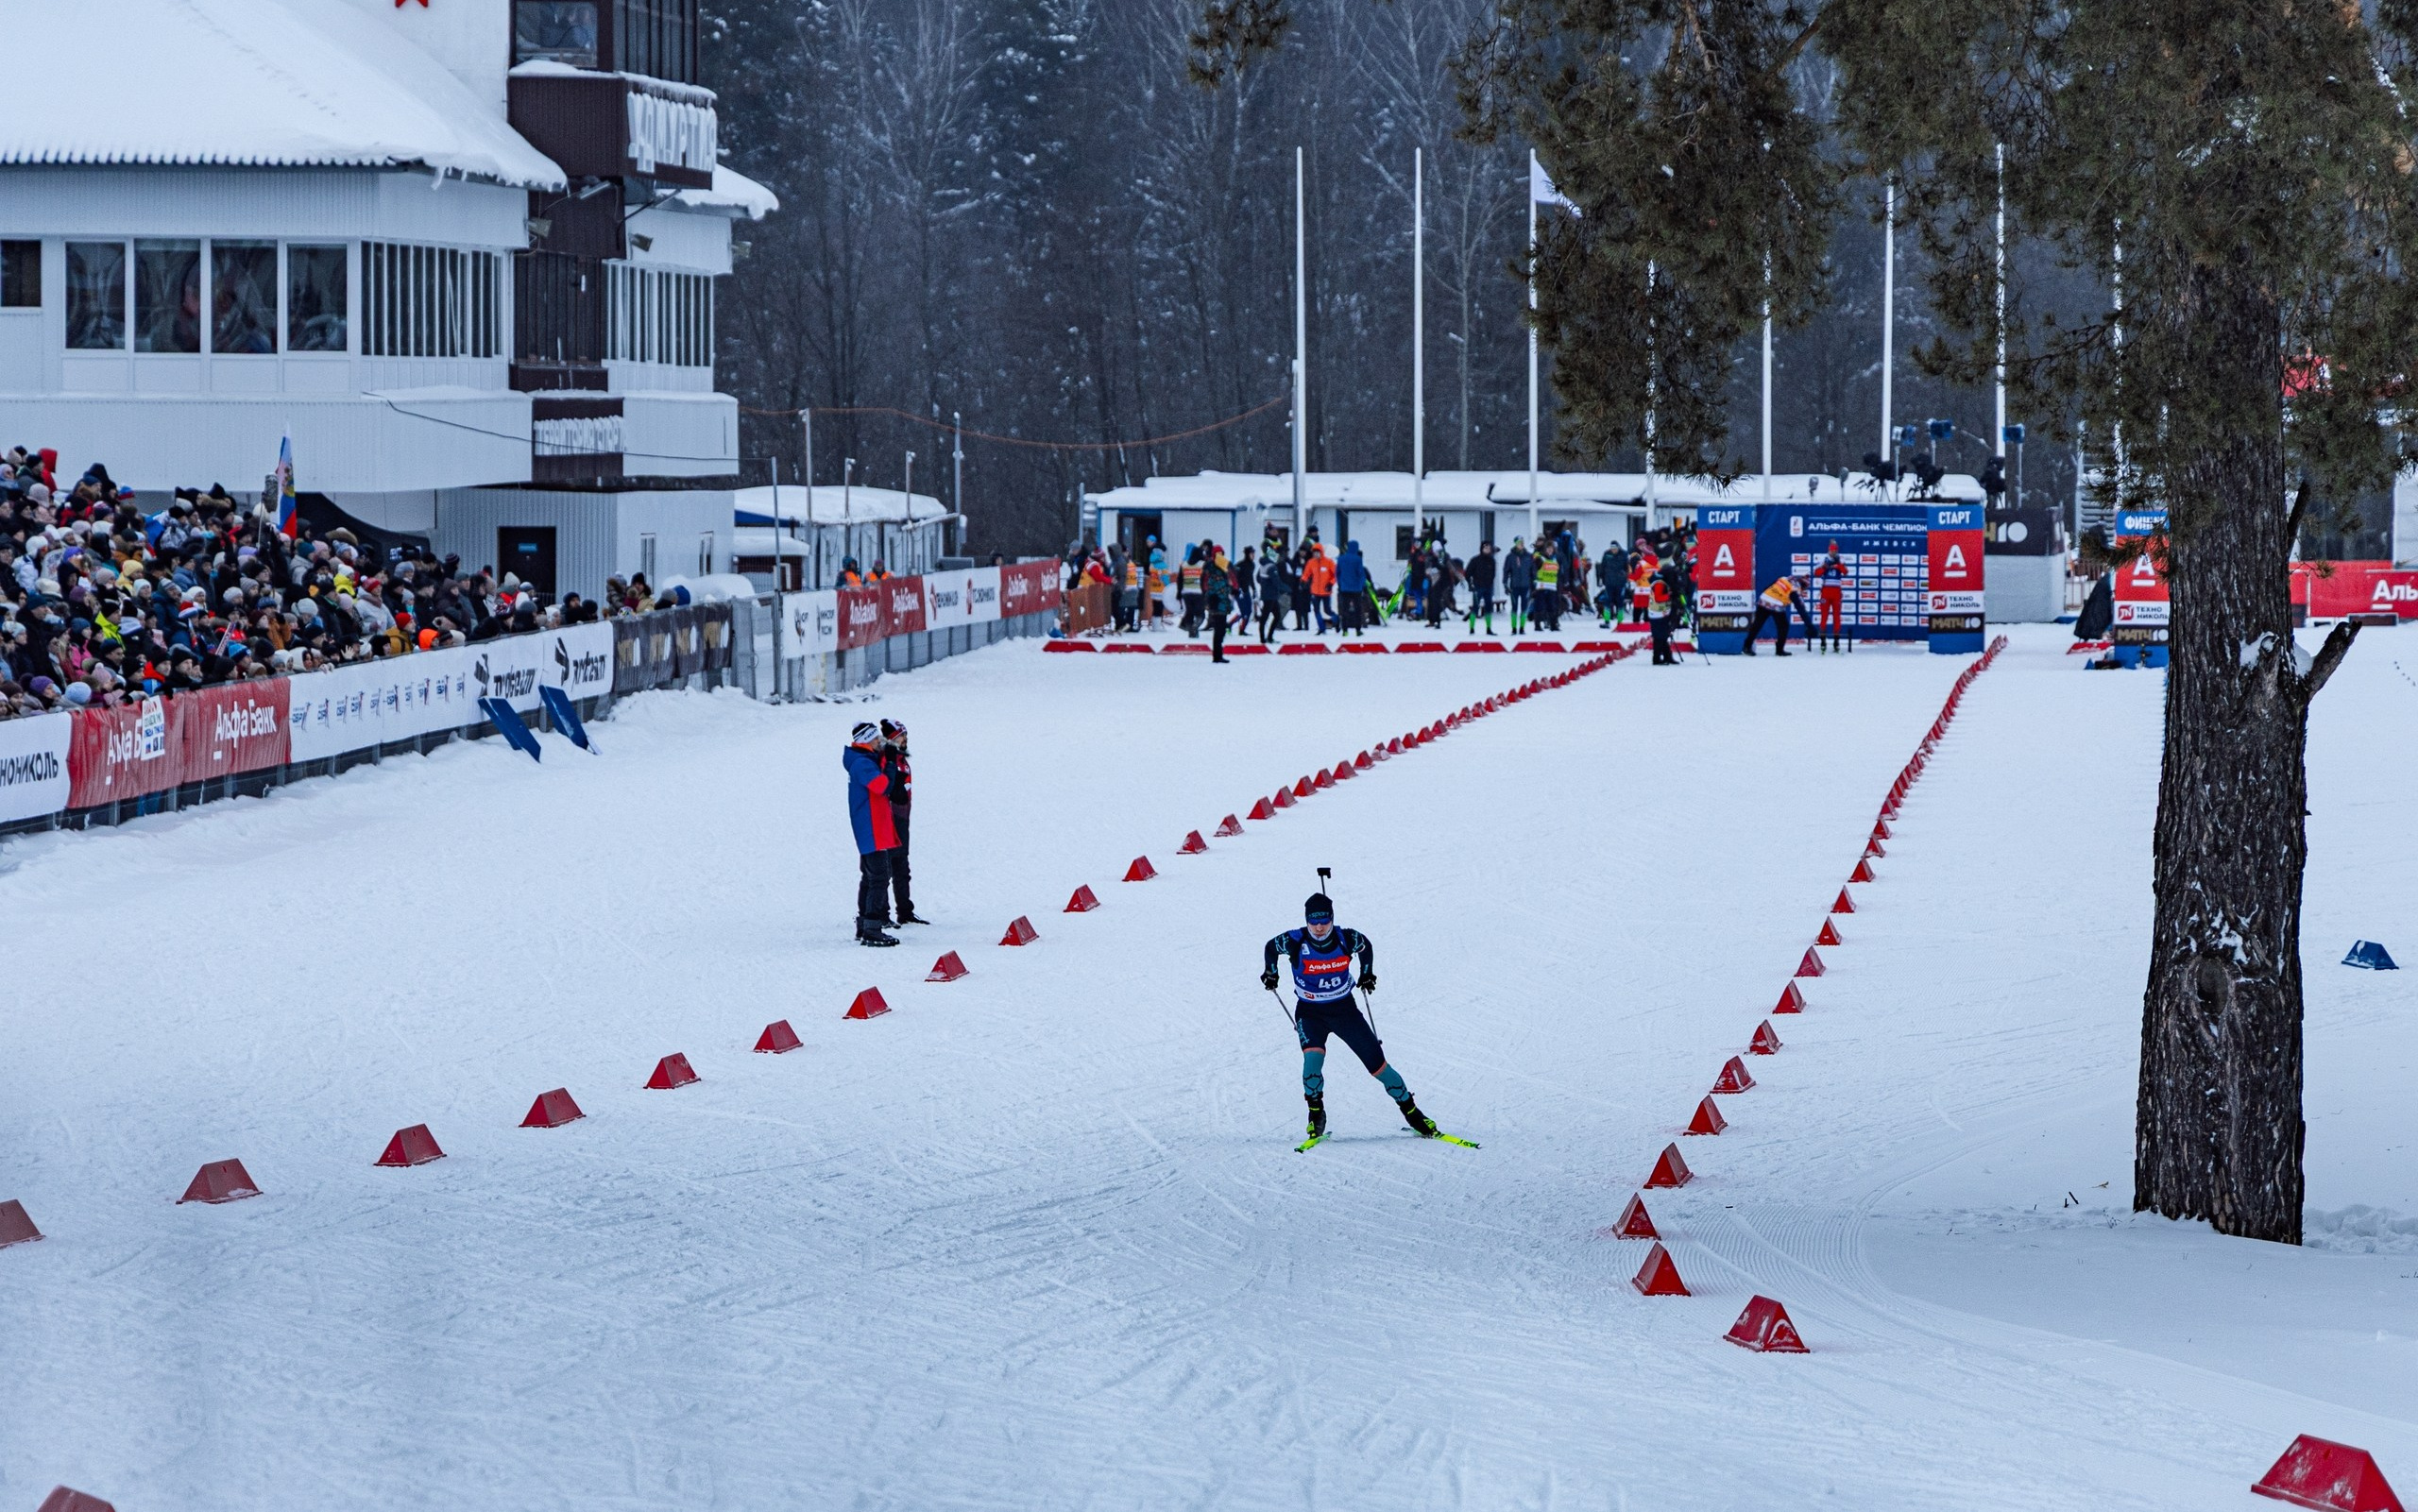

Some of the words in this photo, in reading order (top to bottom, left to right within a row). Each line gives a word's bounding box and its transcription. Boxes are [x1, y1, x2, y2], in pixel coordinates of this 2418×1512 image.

[1708, 510, 1741, 524] СТАРТ
[1938, 511, 1971, 525] СТАРТ
[1808, 522, 1881, 531] АЛЬФА-БАНК
[214, 701, 248, 749] Альфа
[247, 699, 277, 737] Банк
